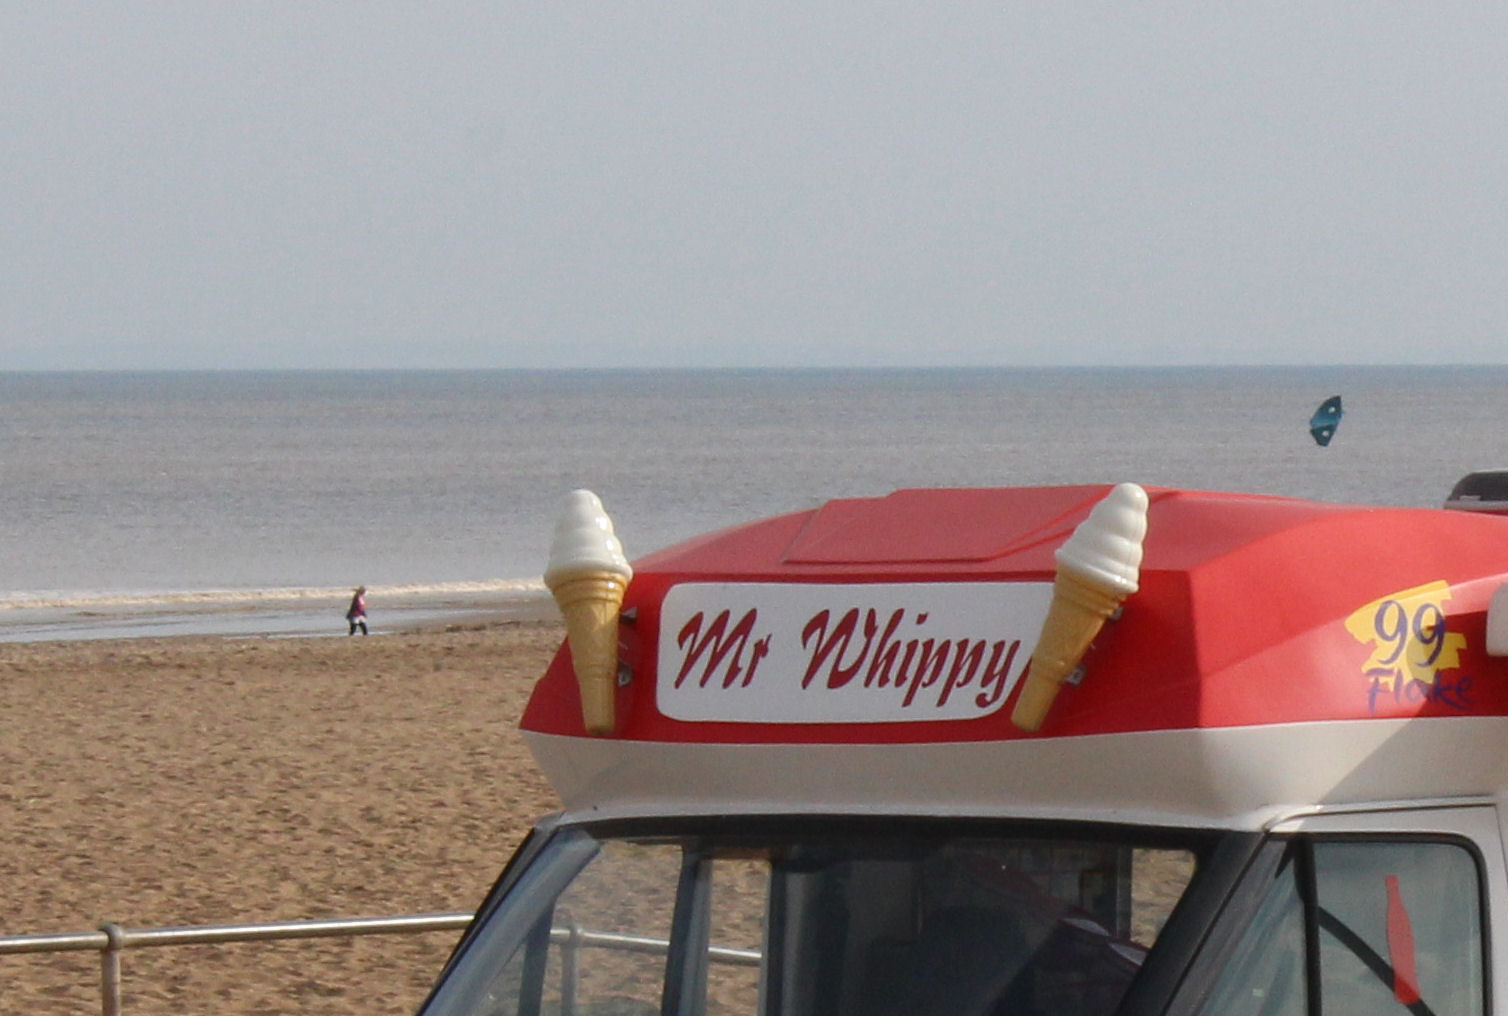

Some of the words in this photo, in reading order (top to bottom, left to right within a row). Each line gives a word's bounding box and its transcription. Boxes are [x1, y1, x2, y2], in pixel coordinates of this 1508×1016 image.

[674, 607, 772, 690] Mr
[801, 606, 1022, 709] Whippy
[1374, 599, 1447, 668] 99
[1363, 666, 1476, 717] Flake
